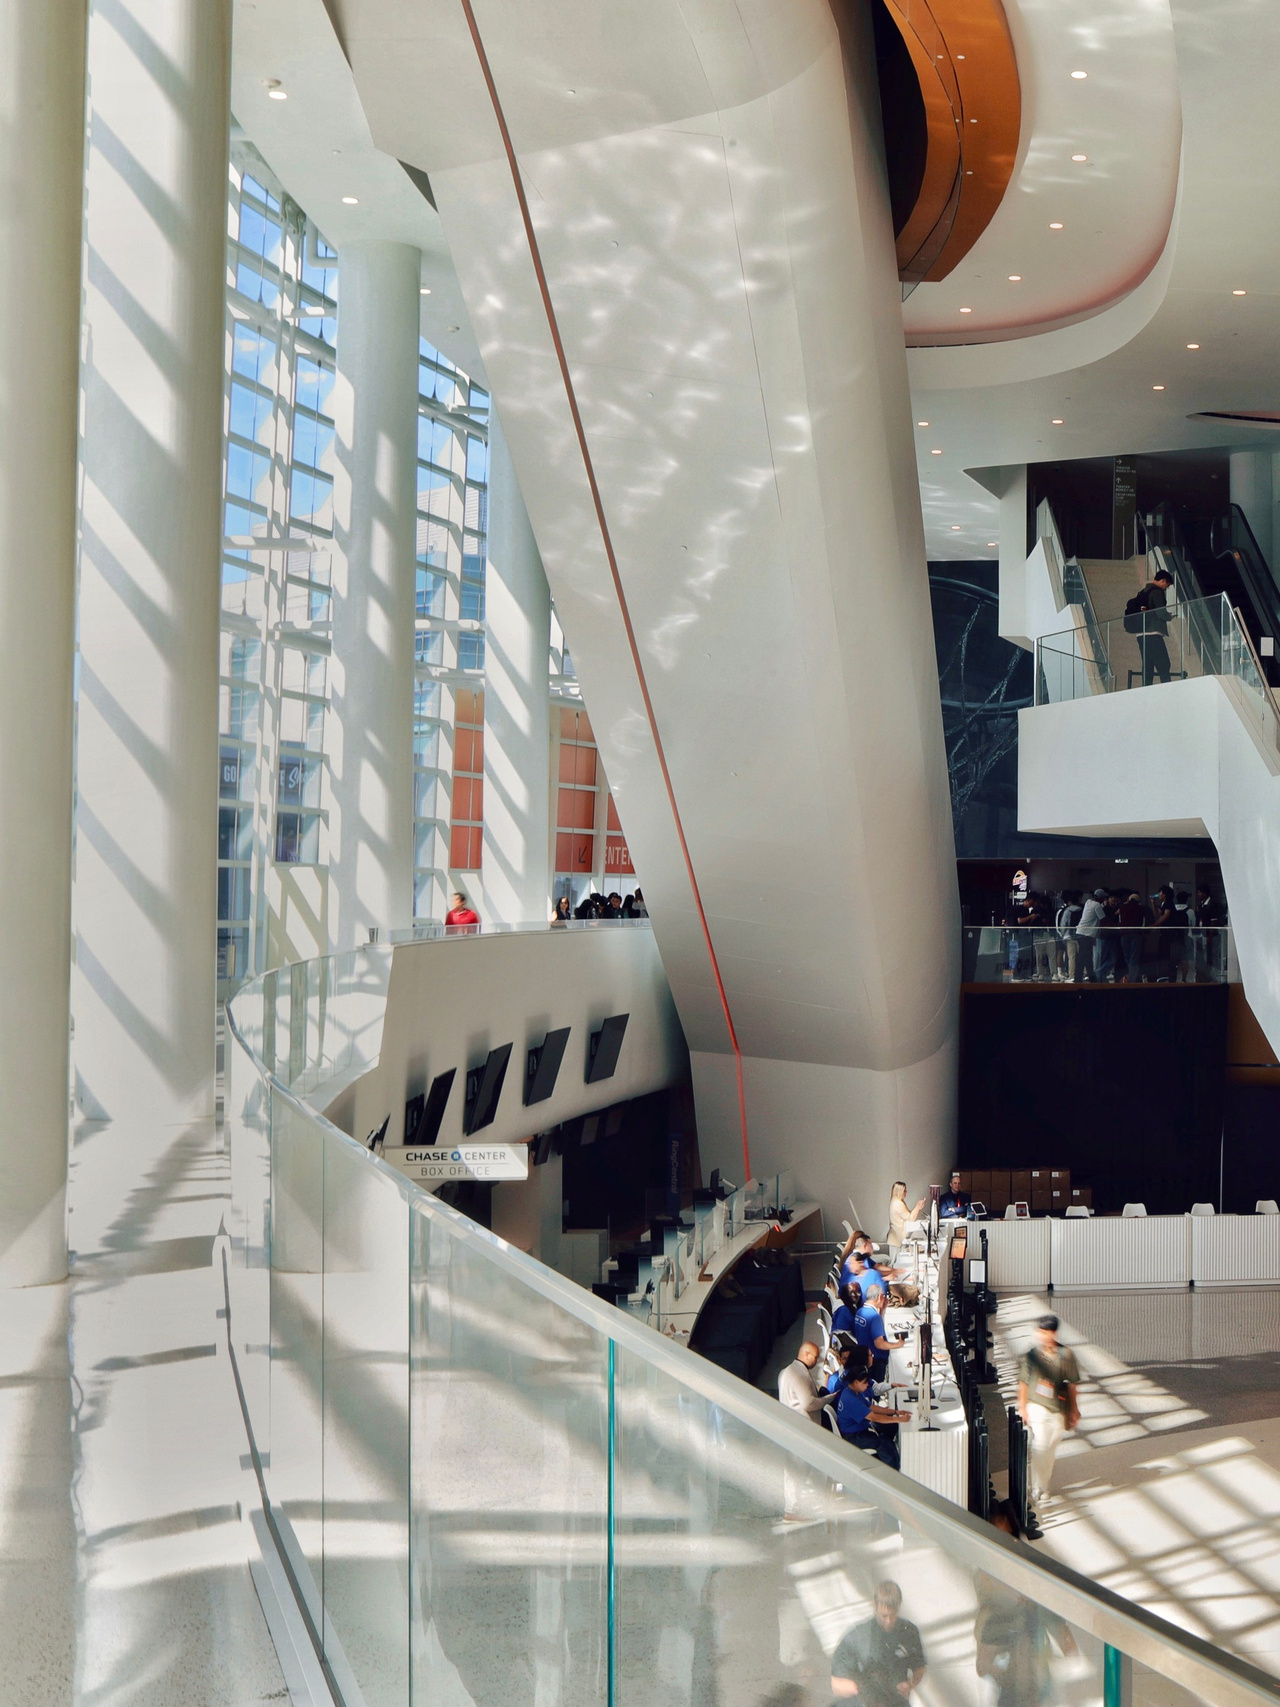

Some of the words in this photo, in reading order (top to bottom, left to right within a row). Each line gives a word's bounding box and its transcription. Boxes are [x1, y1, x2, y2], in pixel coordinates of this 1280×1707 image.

[405, 1152, 448, 1161] CHASE
[464, 1151, 506, 1160] CENTER
[420, 1167, 444, 1176] BOX
[450, 1166, 490, 1176] OFFICE
